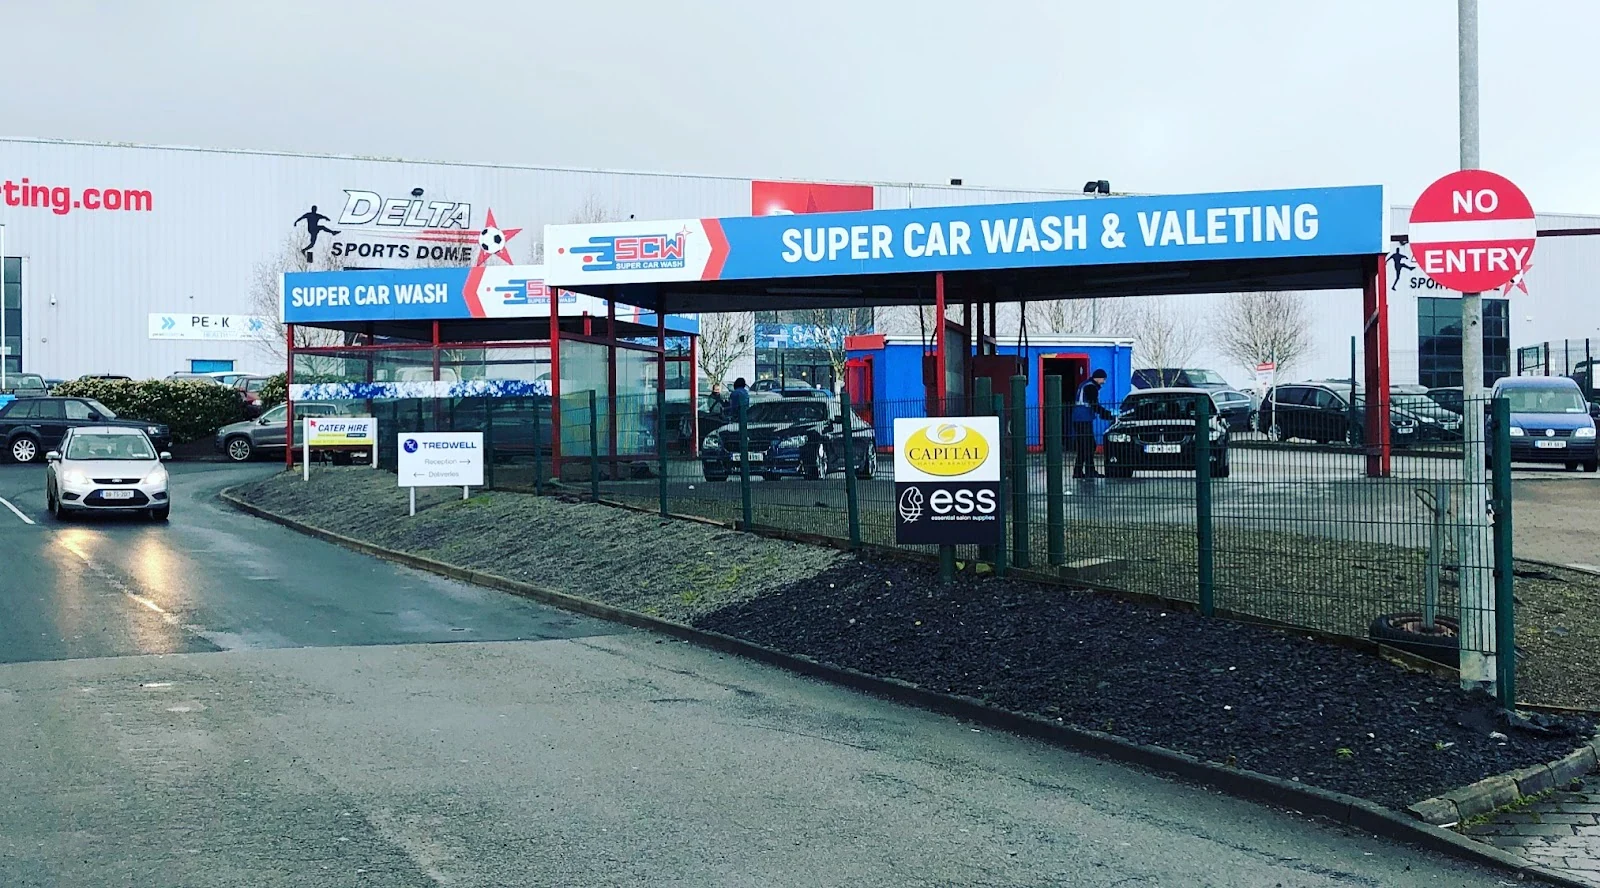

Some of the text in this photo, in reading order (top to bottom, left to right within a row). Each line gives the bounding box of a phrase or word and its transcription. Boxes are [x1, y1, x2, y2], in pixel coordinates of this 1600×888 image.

[0, 178, 152, 215] ting.com
[338, 189, 471, 229] DELTA
[1452, 189, 1498, 214] NO
[782, 203, 1318, 263] SUPER CAR WASH & VALETING
[331, 242, 472, 261] SPORTS DOME
[615, 235, 683, 261] SCW
[1424, 247, 1529, 274] ENTRY
[291, 283, 448, 307] SUPER CAR WASH
[318, 424, 368, 432] CATER HIRE
[909, 447, 983, 461] CAPITAL
[929, 489, 997, 515] ess
